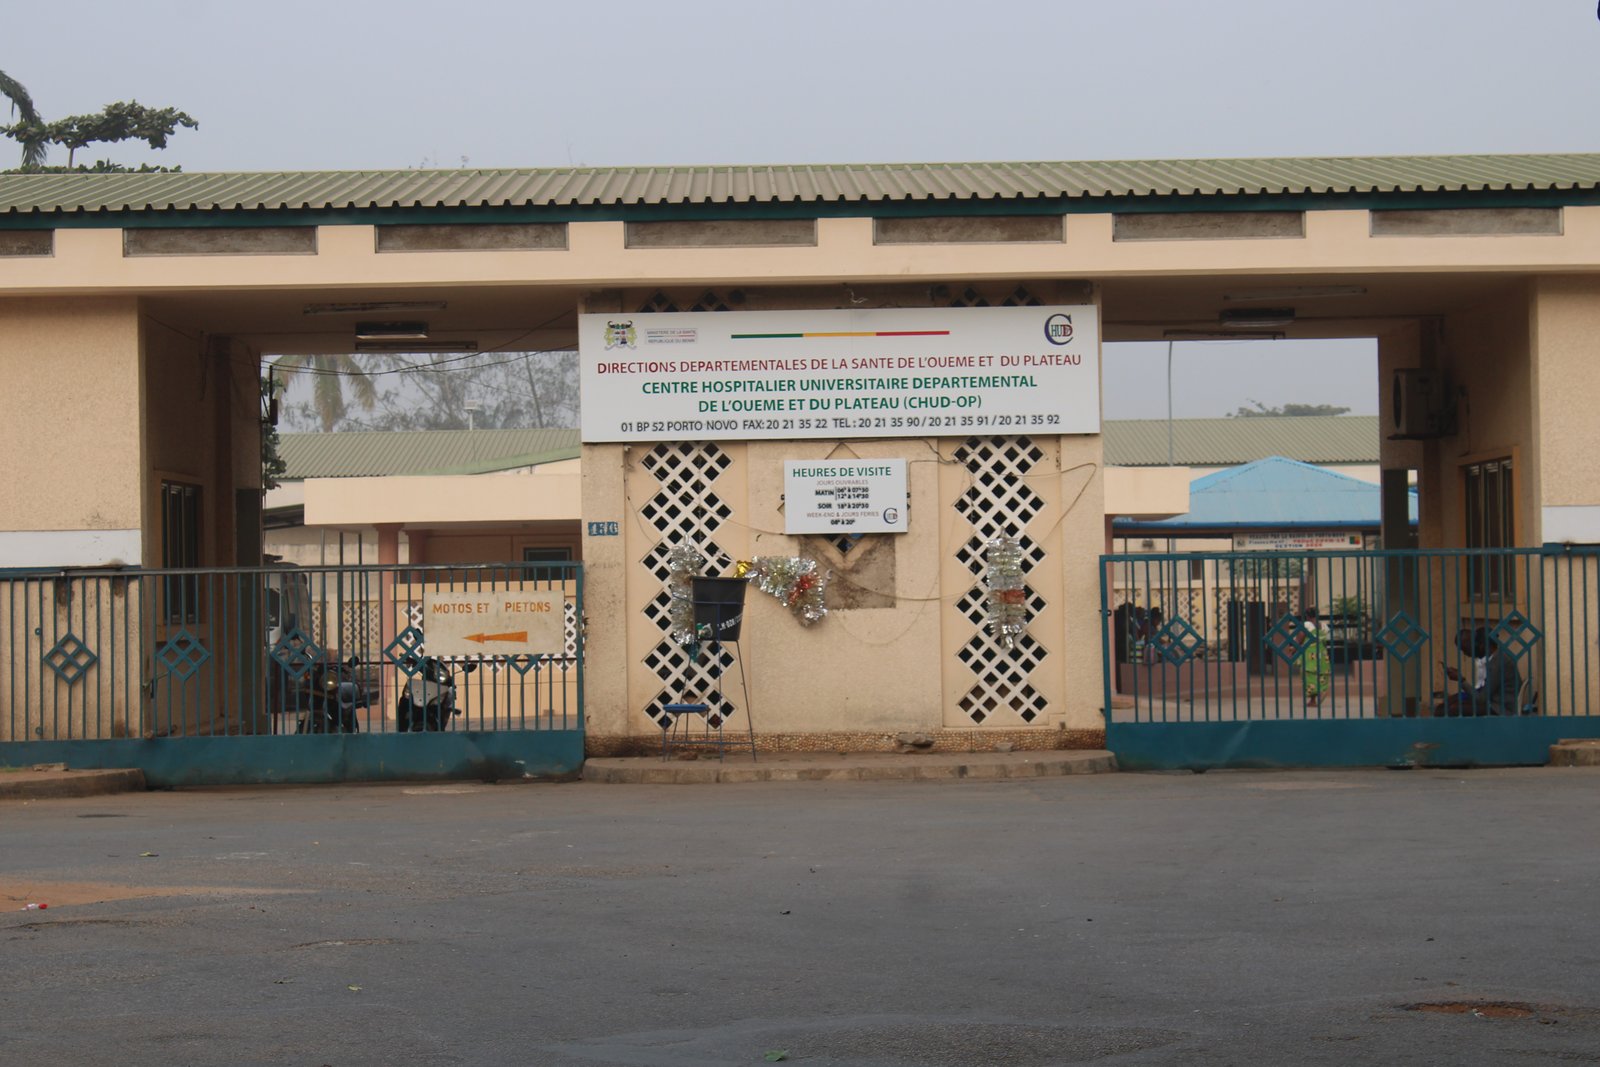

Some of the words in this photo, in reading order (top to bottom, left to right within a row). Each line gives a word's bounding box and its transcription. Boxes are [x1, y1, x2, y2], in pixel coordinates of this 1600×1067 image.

[597, 361, 676, 374] DIRECTIONS
[680, 359, 807, 373] DEPARTEMENTALES
[811, 358, 828, 370] DE
[832, 358, 848, 370] LA
[851, 357, 894, 369] SANTE
[898, 357, 915, 368] DE
[979, 355, 994, 367] ET
[1000, 355, 1020, 367] DU
[1024, 354, 1082, 366] PLATEAU
[642, 381, 698, 394] CENTRE
[702, 379, 796, 393] HOSPITALIER
[800, 378, 908, 391] UNIVERSITAIRE
[912, 376, 1038, 390] DEPARTEMENTAL
[699, 400, 718, 412] DE
[789, 399, 806, 411] ET
[810, 398, 831, 410] DU
[834, 397, 899, 410] PLATEAU
[904, 395, 982, 410] (CHUD-OP)
[621, 422, 633, 432] 01
[636, 422, 650, 432] BP
[652, 422, 665, 432] 52
[667, 421, 703, 432] PORTO
[706, 420, 738, 430] NOVO
[766, 419, 779, 430] 20
[782, 419, 794, 429] 21
[799, 419, 811, 429] 35
[815, 418, 828, 429] 22
[858, 418, 871, 428] 20
[874, 417, 886, 427] 21
[891, 417, 903, 427] 35
[945, 416, 956, 426] 21
[960, 416, 973, 426] 35
[1015, 415, 1027, 425] 21
[1031, 415, 1044, 425] 35
[1047, 414, 1060, 425] 92
[793, 467, 836, 477] HEURES
[840, 467, 854, 476] DE
[856, 466, 892, 476] VISITE
[432, 603, 472, 614] MOTOS
[476, 603, 490, 613] ET
[505, 602, 551, 612] PIETONS
